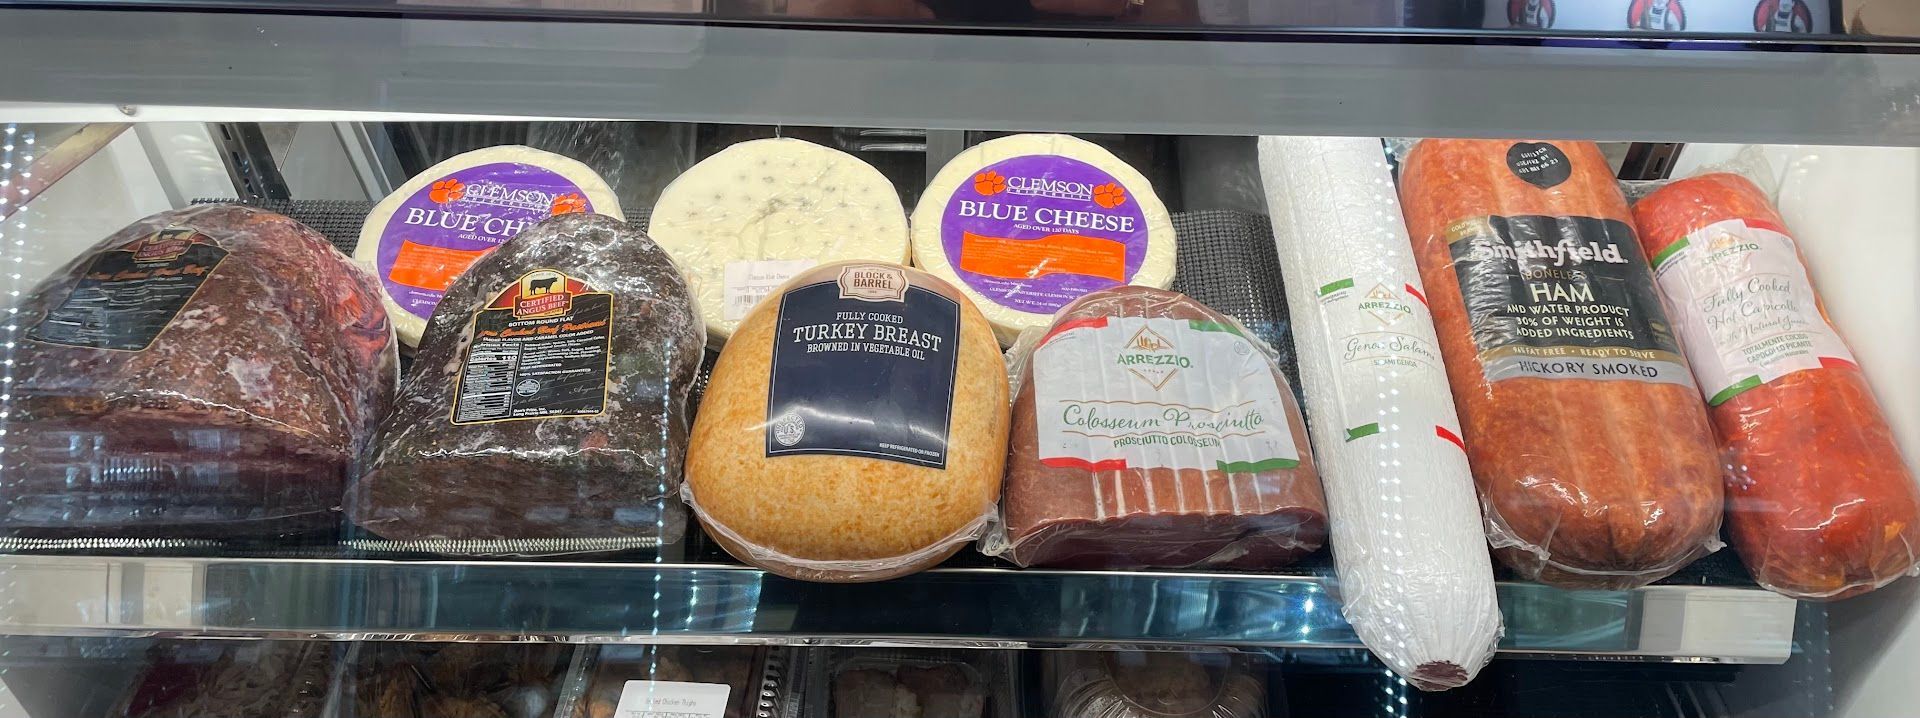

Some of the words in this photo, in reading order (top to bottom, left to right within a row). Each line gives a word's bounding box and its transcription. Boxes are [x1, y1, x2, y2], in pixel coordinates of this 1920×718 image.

[1007, 176, 1095, 196] CLEMSON
[466, 183, 556, 206] CLEMSON
[404, 207, 480, 232] BLUE
[958, 199, 1029, 222] BLUE
[1034, 207, 1136, 233] CHEESE
[477, 235, 497, 243] OVER
[1062, 227, 1080, 235] DAYS
[854, 271, 886, 279] BLOCK
[853, 279, 893, 290] BARREL
[1530, 281, 1594, 303] HAM
[519, 294, 565, 308] CERTIFIED
[1704, 286, 1744, 312] Fully
[1747, 277, 1791, 294] Cooked
[516, 304, 547, 316] ANGUS
[547, 300, 567, 310] BEEF
[1506, 303, 1527, 314] AND
[1529, 303, 1573, 315] WATER
[1575, 304, 1630, 317] PRODUCT
[508, 319, 536, 328] BOTTOM
[536, 317, 559, 326] ROUND
[560, 315, 574, 323] FLAT
[835, 311, 867, 321] FULLY
[868, 312, 903, 324] COOKED
[1515, 316, 1539, 327] 30%
[1541, 316, 1559, 326] OF
[1562, 316, 1613, 327] WEIGHT
[1615, 316, 1625, 328] IS
[792, 322, 869, 343] TURKEY
[873, 324, 942, 352] BREAST
[1516, 327, 1553, 338] ADDED
[1556, 327, 1635, 340] INGREDIENTS
[806, 342, 849, 353] BROWNED
[850, 342, 861, 352] IN
[862, 343, 910, 357] VEGETABLE
[911, 348, 925, 361] OIL
[1388, 336, 1435, 361] Salami
[1525, 347, 1540, 355] FAT
[1543, 347, 1567, 356] FREE
[1580, 348, 1610, 357] READY
[1614, 348, 1626, 356] TO
[1629, 350, 1656, 359] SERVE
[1117, 353, 1192, 369] ARREZZIO
[1518, 361, 1585, 375] HICKORY
[1592, 362, 1659, 378] SMOKED
[1062, 404, 1160, 430] Colosseum
[1163, 407, 1265, 432] Prosciutto
[1113, 435, 1169, 448] PROSCIUTTO
